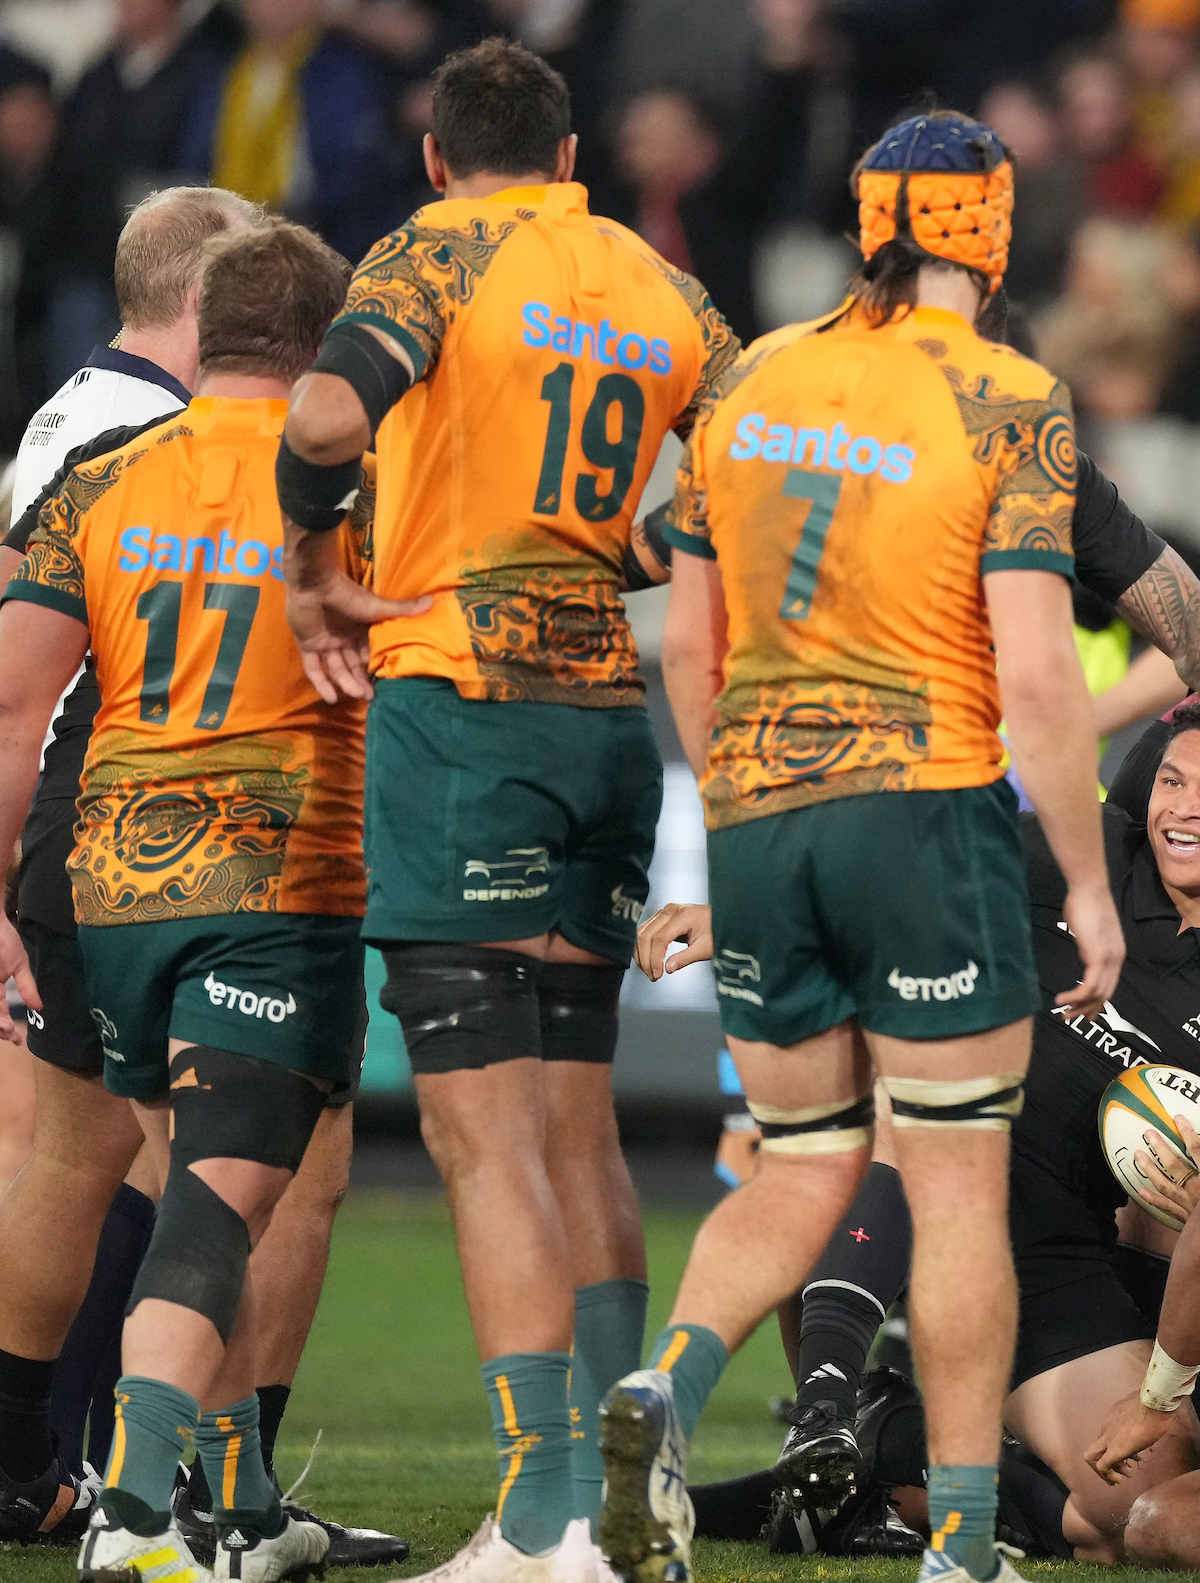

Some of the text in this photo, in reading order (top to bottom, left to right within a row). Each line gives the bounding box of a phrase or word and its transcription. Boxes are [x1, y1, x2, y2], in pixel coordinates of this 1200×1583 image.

[522, 301, 672, 376] Santos
[533, 362, 645, 522] 19
[729, 413, 915, 483] Santos
[779, 468, 843, 620] 7
[136, 580, 261, 730] 17
[1182, 1022, 1198, 1038] ALL
